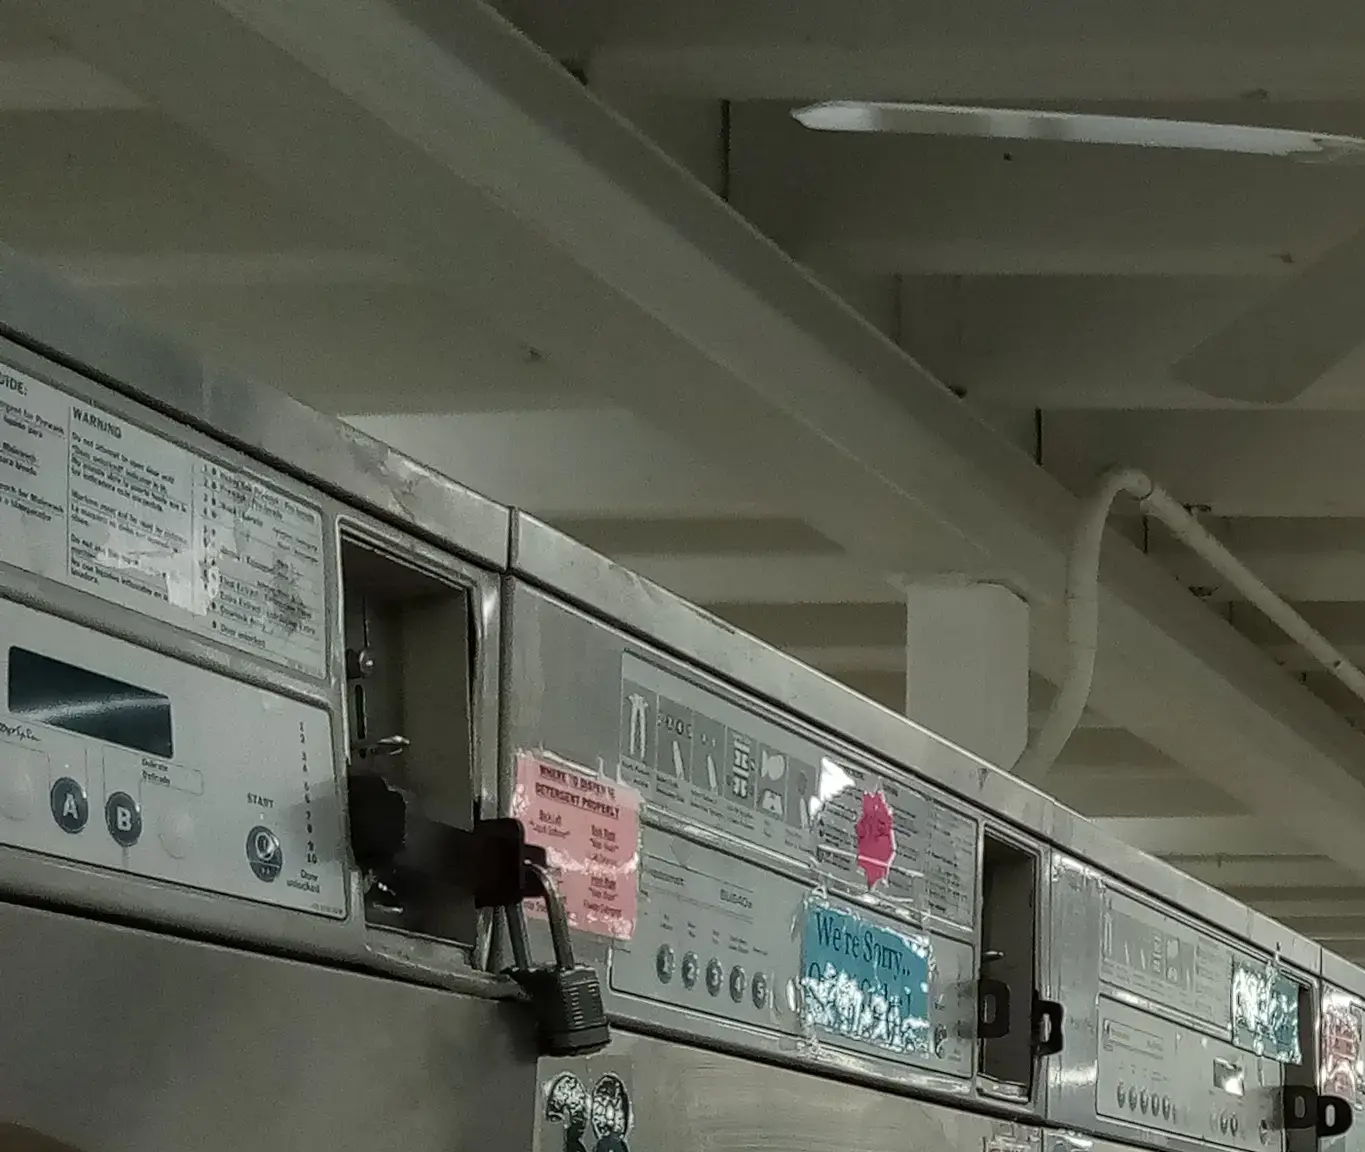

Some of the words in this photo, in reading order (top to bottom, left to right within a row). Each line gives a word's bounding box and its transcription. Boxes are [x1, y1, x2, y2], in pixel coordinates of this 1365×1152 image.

[0, 374, 28, 397] IDE:
[72, 406, 122, 439] WARNING
[62, 793, 79, 820] A
[116, 806, 132, 832] B
[815, 911, 860, 960] We're
